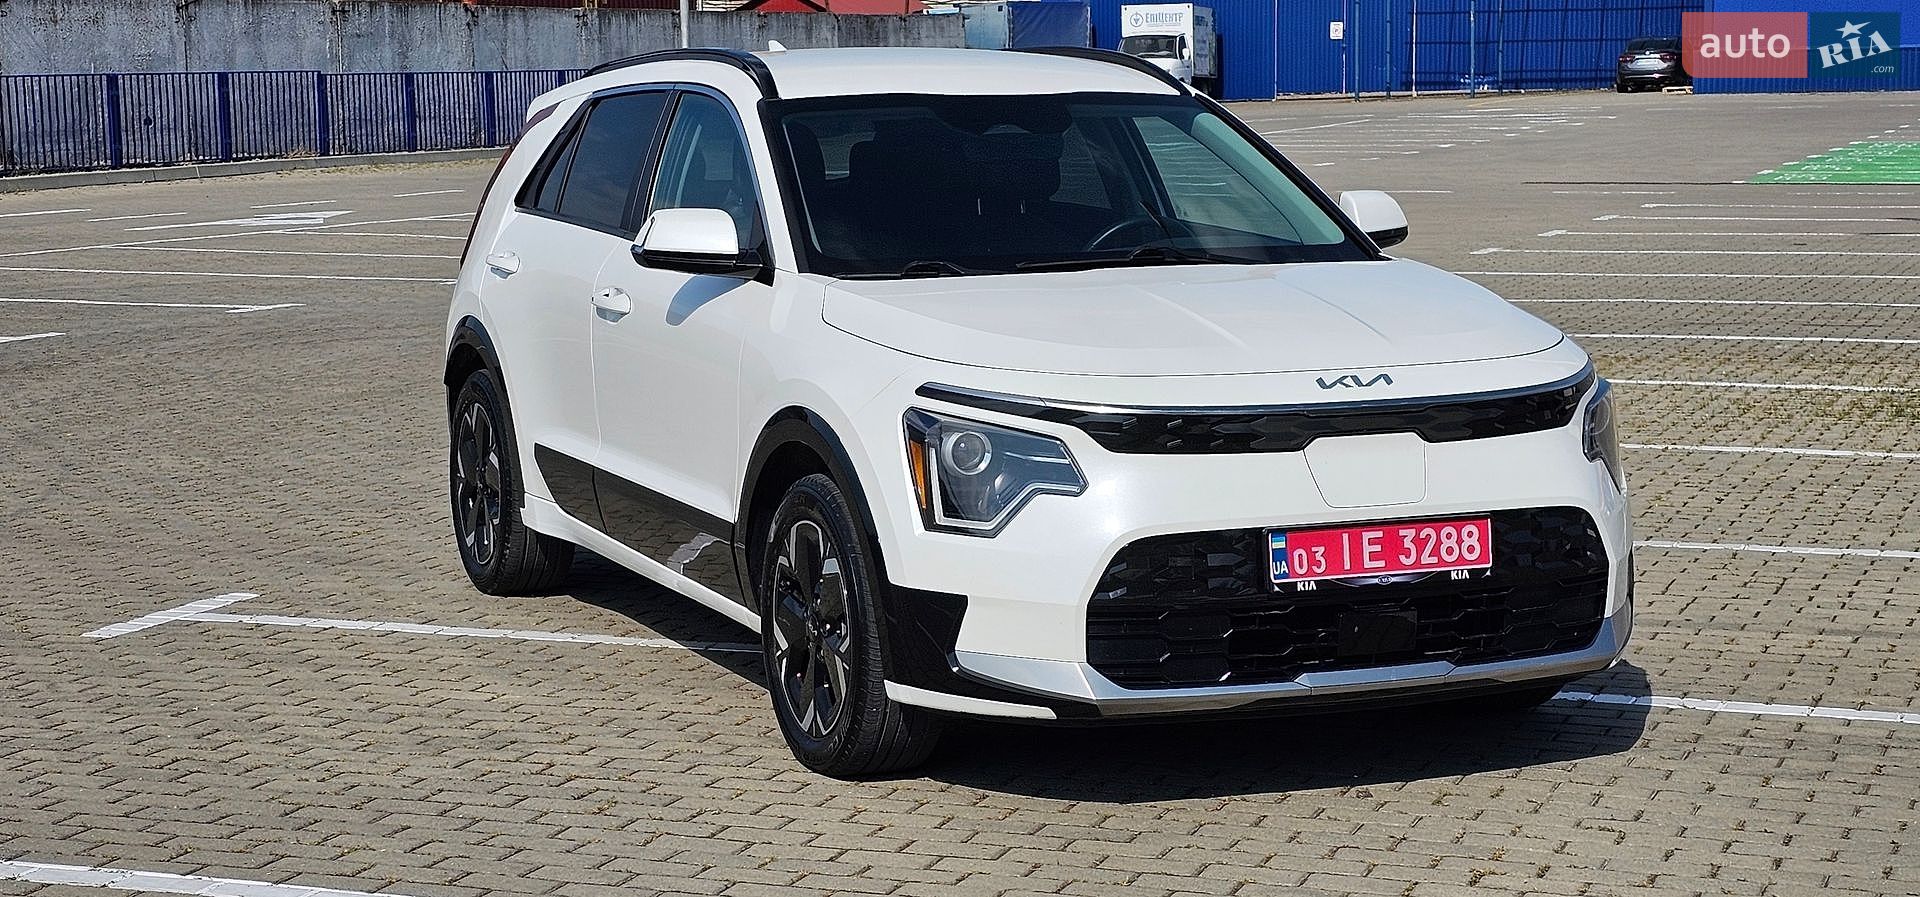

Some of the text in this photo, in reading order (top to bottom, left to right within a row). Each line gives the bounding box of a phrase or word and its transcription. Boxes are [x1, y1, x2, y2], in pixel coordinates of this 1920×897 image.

[1293, 546, 1327, 575] 03
[1398, 524, 1482, 566] 3288
[1273, 561, 1289, 575] UA
[1450, 569, 1470, 581] KIA
[1296, 580, 1317, 591] KIA
